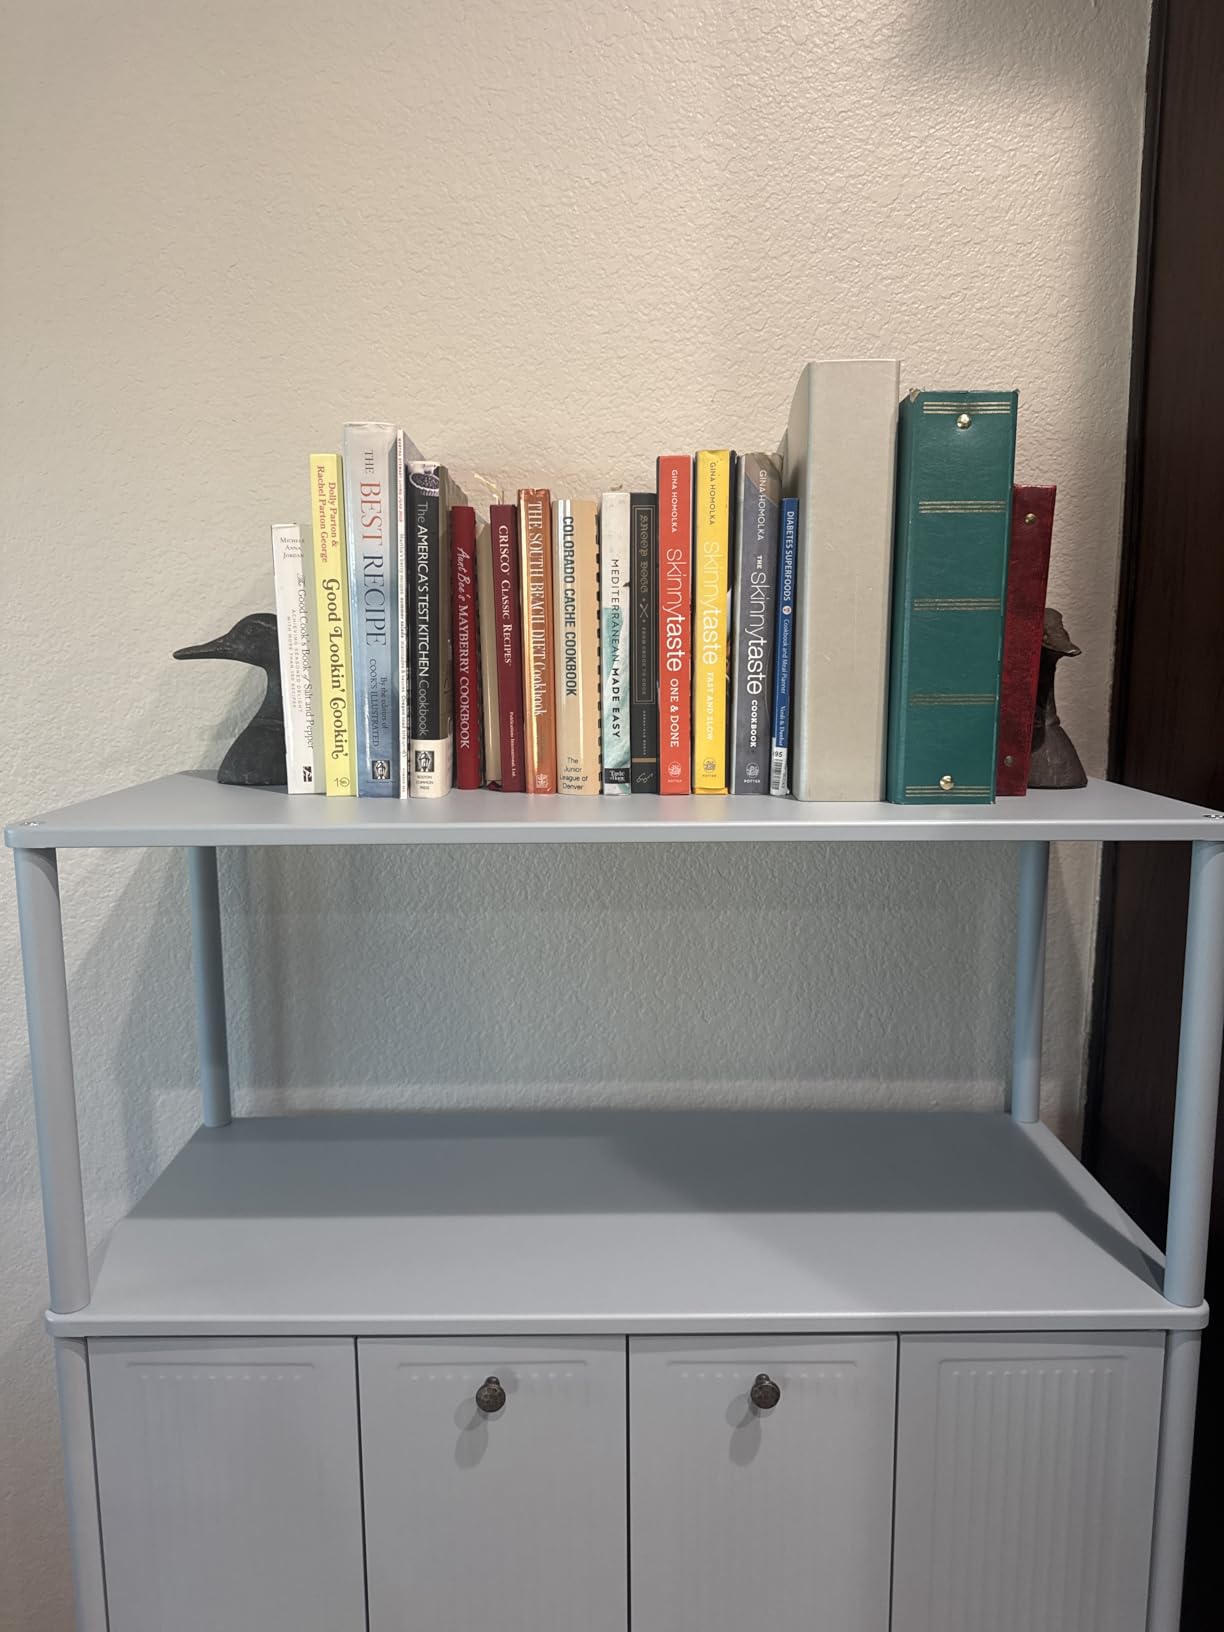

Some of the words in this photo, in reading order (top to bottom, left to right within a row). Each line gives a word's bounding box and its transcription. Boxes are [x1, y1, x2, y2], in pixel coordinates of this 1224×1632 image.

[364, 450, 375, 474] THE
[317, 465, 327, 497] Rachel
[327, 482, 337, 505] Dolly
[759, 469, 767, 493] GINA
[318, 498, 328, 530] Parton
[330, 508, 338, 538] Parton
[360, 481, 383, 546] BEST
[417, 501, 429, 524] The
[528, 501, 543, 529] THE
[757, 494, 767, 541] HOMOLKA
[331, 539, 338, 548] &
[785, 511, 795, 549] DIABETES
[320, 531, 329, 563] George
[417, 524, 429, 592] AMERICA'S
[457, 547, 471, 573] Aunt
[528, 533, 544, 577] SOUTH
[563, 516, 576, 584] COLORADO
[457, 572, 472, 602] Bee's
[783, 550, 793, 601] SUPERFOODS
[298, 589, 308, 614] Good
[322, 578, 342, 622] Good
[363, 555, 387, 646] RECIPE
[418, 594, 429, 623] TEST
[530, 582, 545, 624] BEACH
[564, 588, 576, 628] CACHE
[611, 559, 620, 662] MEDITERRANEAN
[300, 616, 310, 646] Cook's
[458, 604, 470, 674] MAYBERRY
[531, 629, 546, 659] DIET
[302, 649, 311, 671] Book
[329, 626, 346, 693] Lookin'
[418, 624, 430, 677] KITCHEN
[565, 631, 577, 696] COOKBOOK
[370, 658, 379, 690] COOK'S
[379, 677, 387, 686] By
[532, 662, 547, 716] Cookbook
[611, 668, 620, 702] MADE
[670, 678, 679, 702] ONE
[706, 671, 714, 694] FAST
[304, 683, 313, 699] Salt
[706, 695, 714, 713] AND
[305, 702, 314, 716] and
[370, 691, 380, 747] ILLUSTRATED
[418, 679, 430, 736] Cookbook
[459, 676, 470, 749] COOKBOOK
[612, 707, 620, 738] EASY
[670, 704, 679, 713] &
[750, 699, 758, 748] COOKBOOK
[304, 720, 314, 749] Pepper
[330, 697, 348, 760] Cookin'
[670, 715, 680, 748] DONE
[706, 715, 715, 742] SLOW
